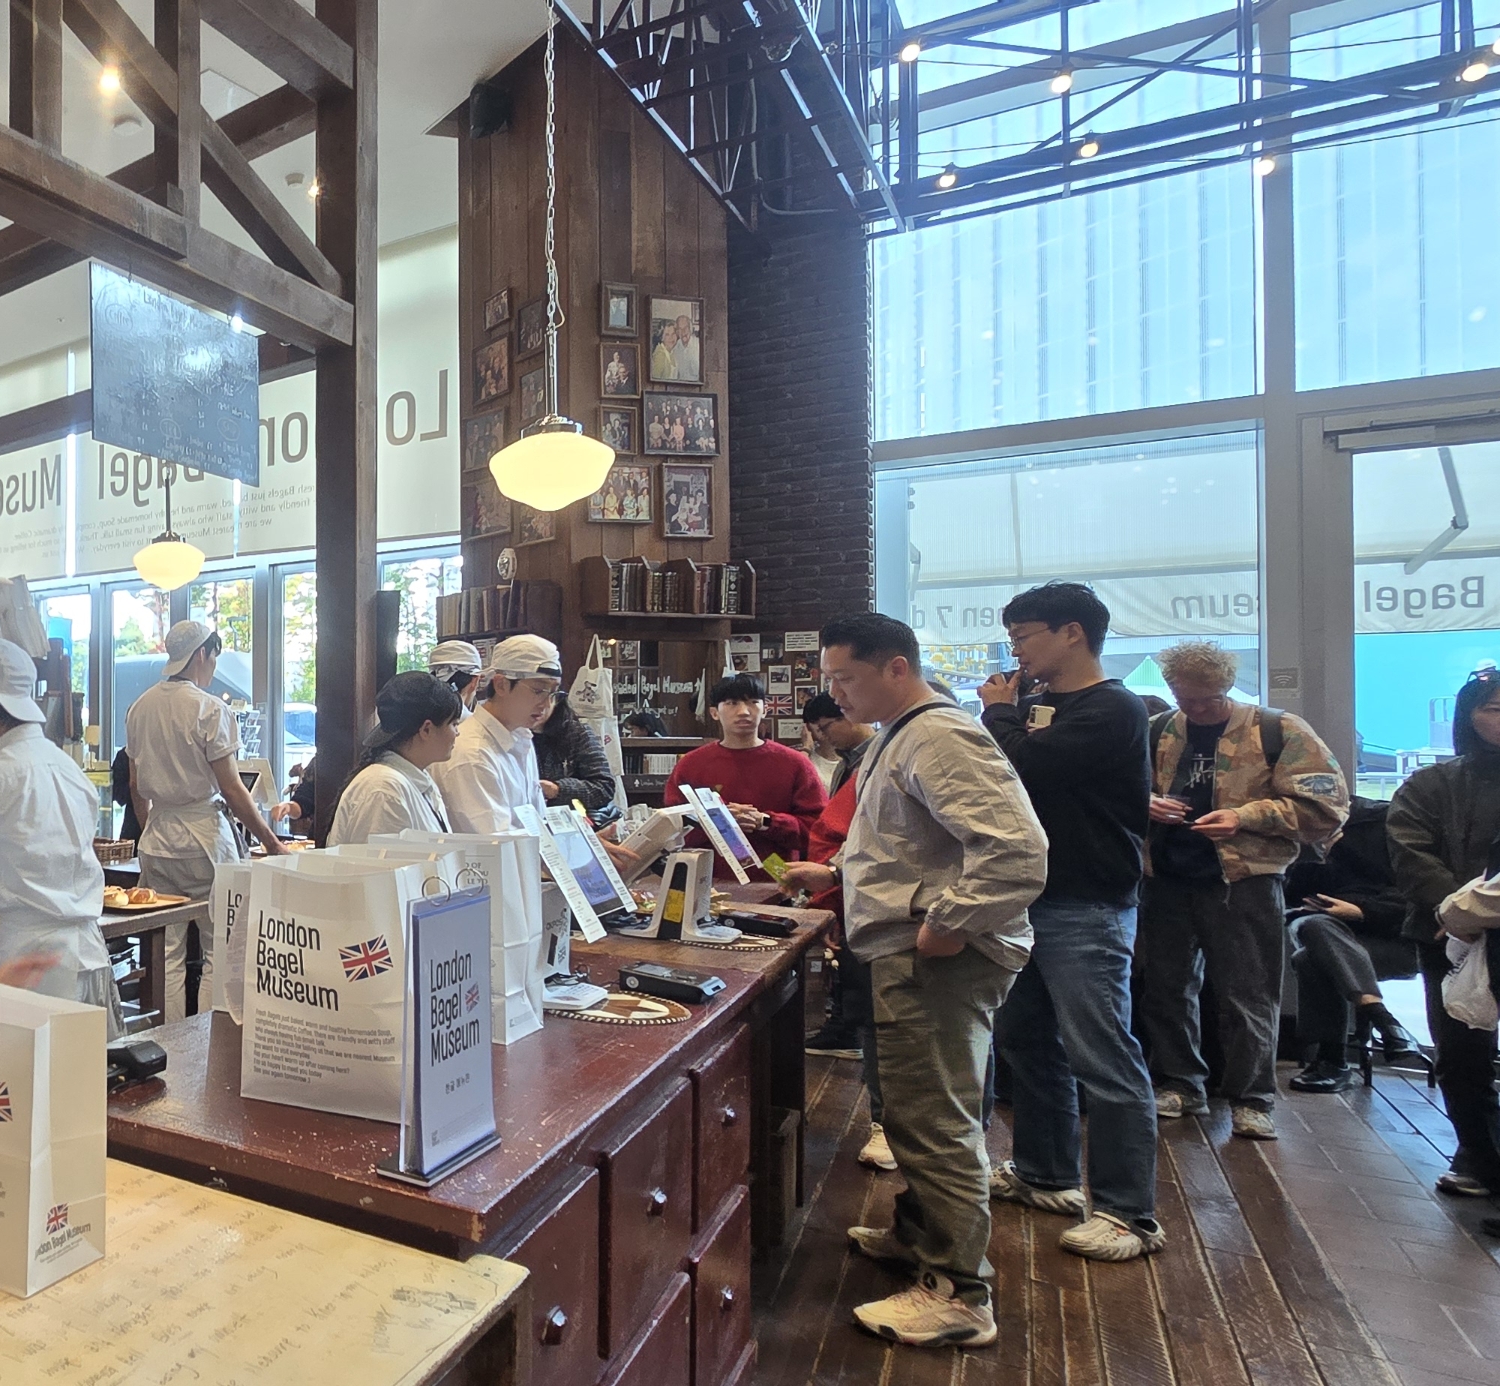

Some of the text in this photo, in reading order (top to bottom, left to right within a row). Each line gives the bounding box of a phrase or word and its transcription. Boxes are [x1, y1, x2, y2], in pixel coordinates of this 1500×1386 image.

[258, 910, 321, 951] London
[257, 938, 304, 976] Bagel
[430, 950, 472, 993] London
[256, 967, 339, 1012] Museum
[430, 984, 462, 1031] Bagel
[430, 1017, 480, 1067] Museum
[66, 1223, 91, 1241] Museum
